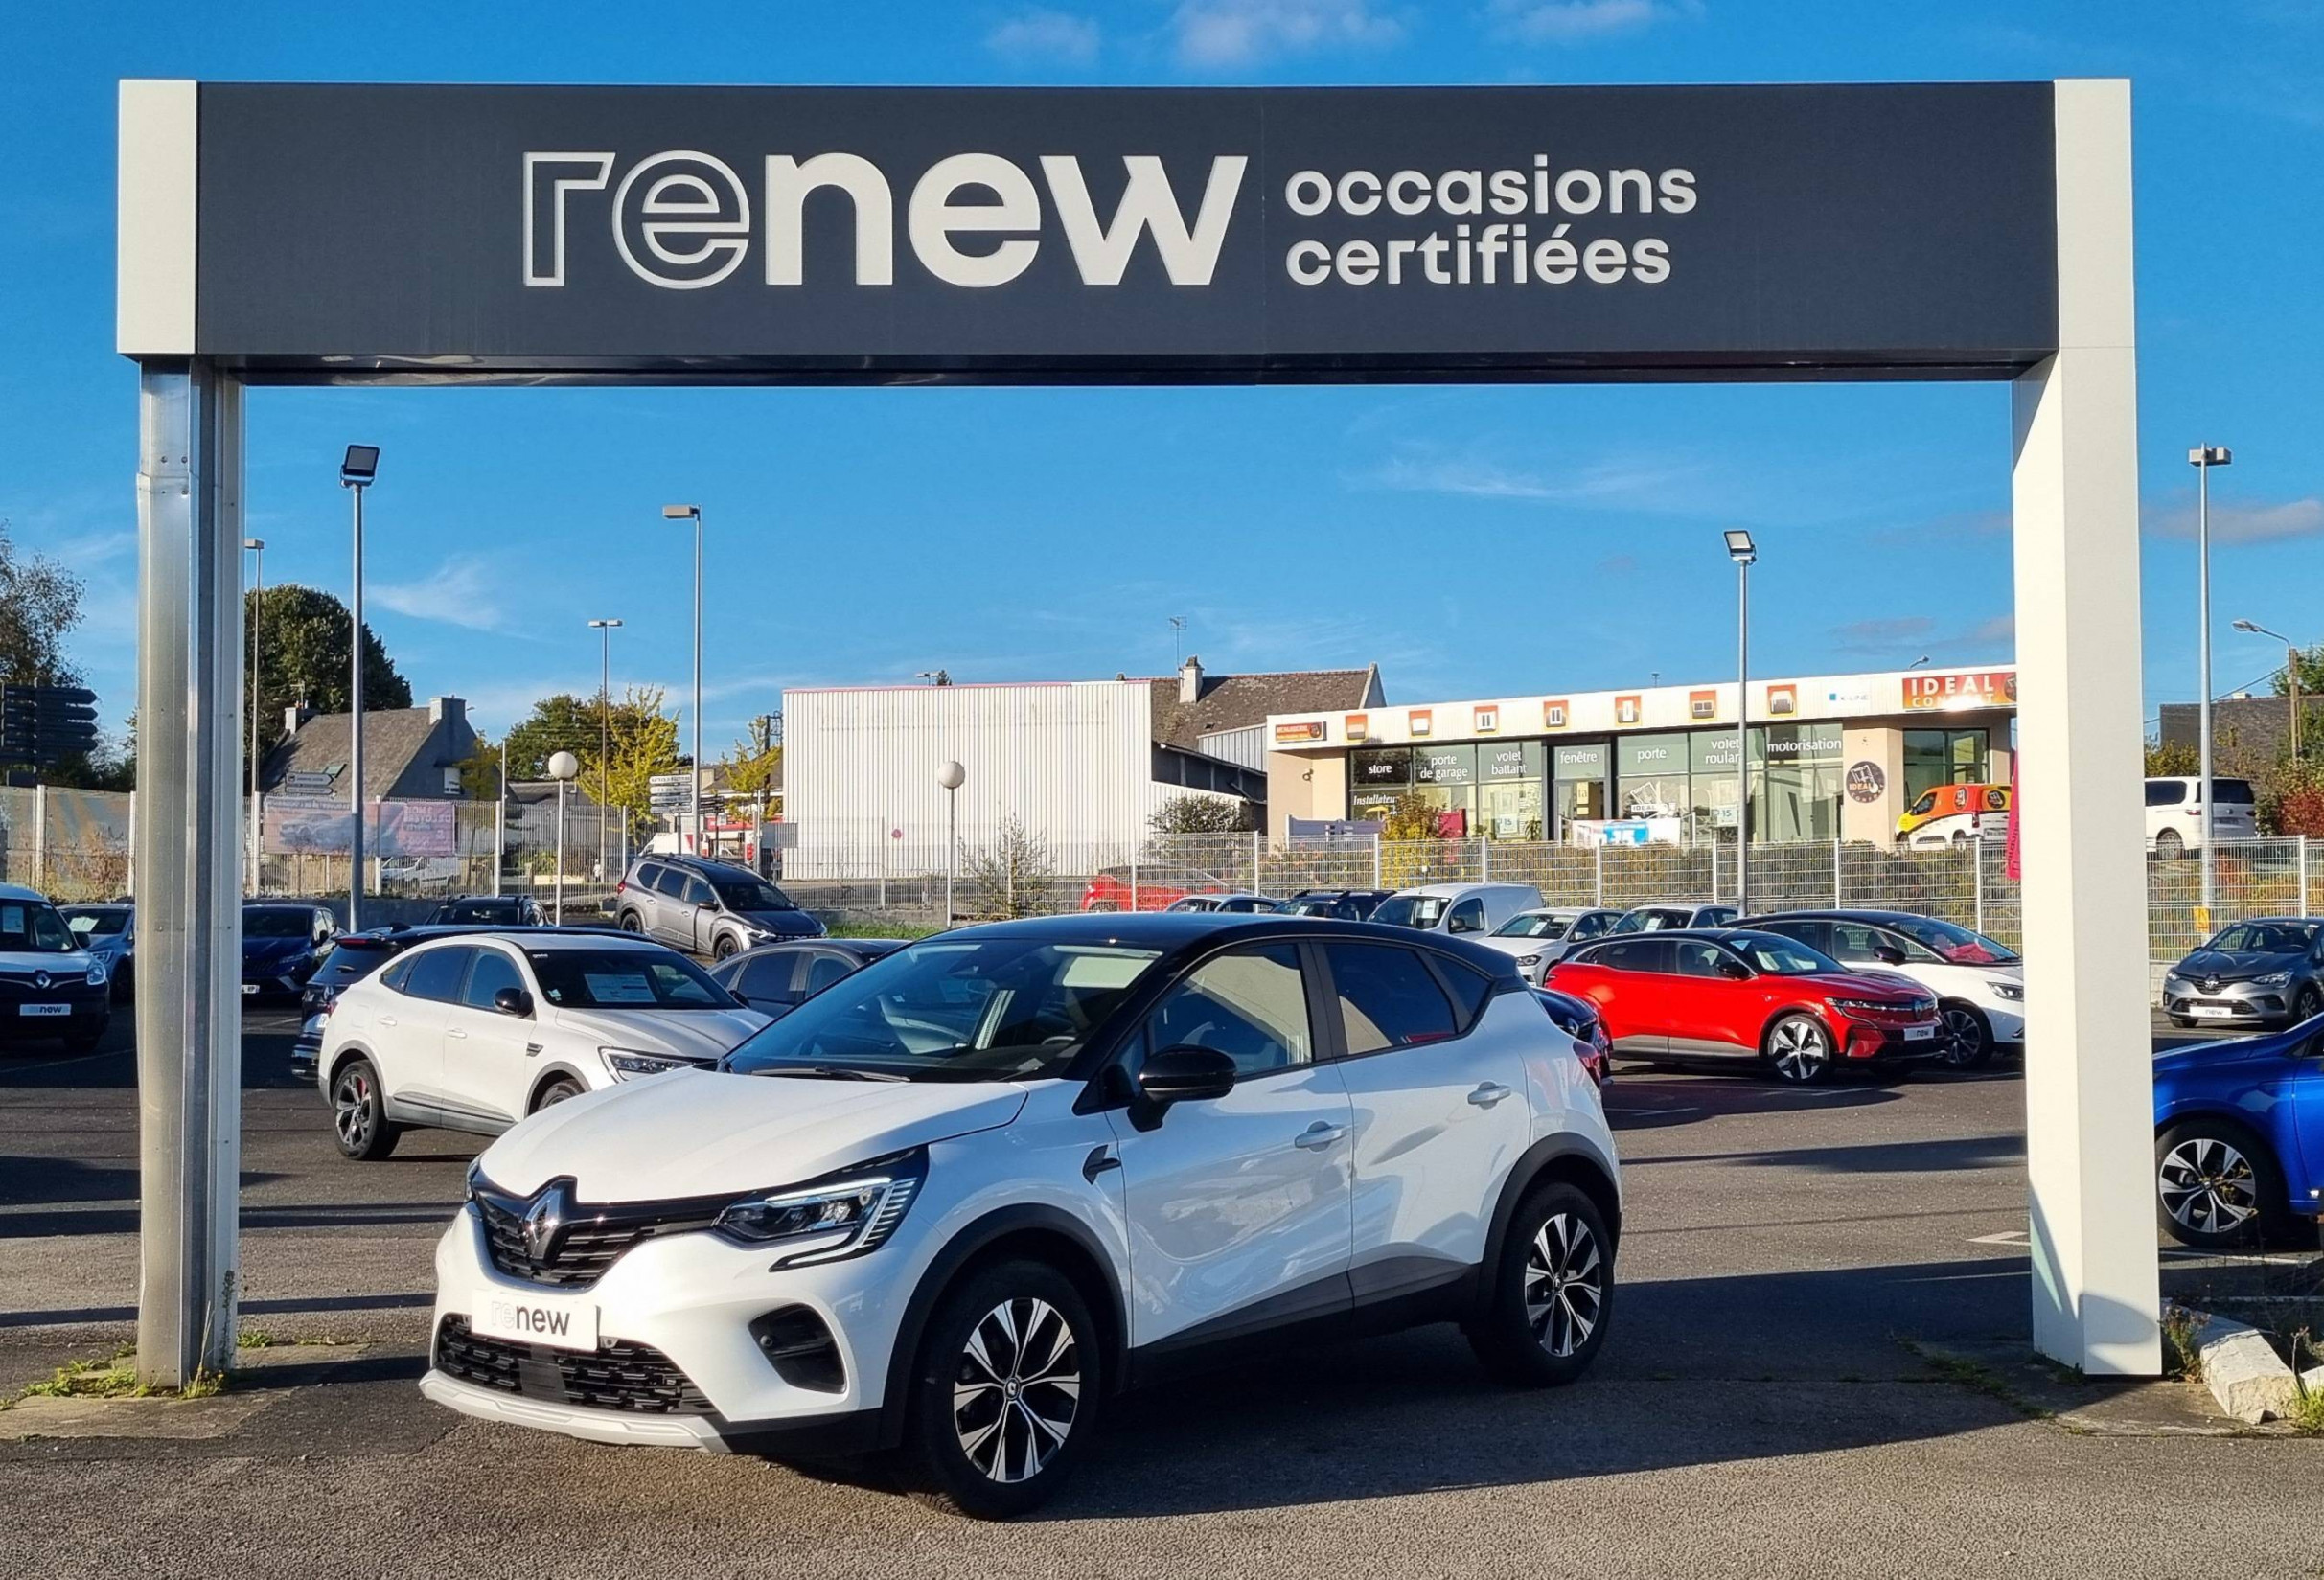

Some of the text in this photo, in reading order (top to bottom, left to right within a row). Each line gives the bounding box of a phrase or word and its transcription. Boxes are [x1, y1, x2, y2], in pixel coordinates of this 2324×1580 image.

[1285, 153, 1698, 216] occasions
[523, 150, 1248, 289] renew
[1286, 223, 1671, 286] certifiées
[1911, 675, 1994, 696] IDEAL
[1911, 693, 1994, 708] CONT
[1767, 737, 1842, 752] motorisation
[1431, 754, 1457, 768] porte
[1496, 750, 1522, 762] volet
[1560, 750, 1598, 764] fenêtre
[1637, 747, 1667, 763] porte
[1369, 764, 1392, 774] store
[1420, 767, 1468, 782] de garage
[1491, 764, 1527, 775] battant
